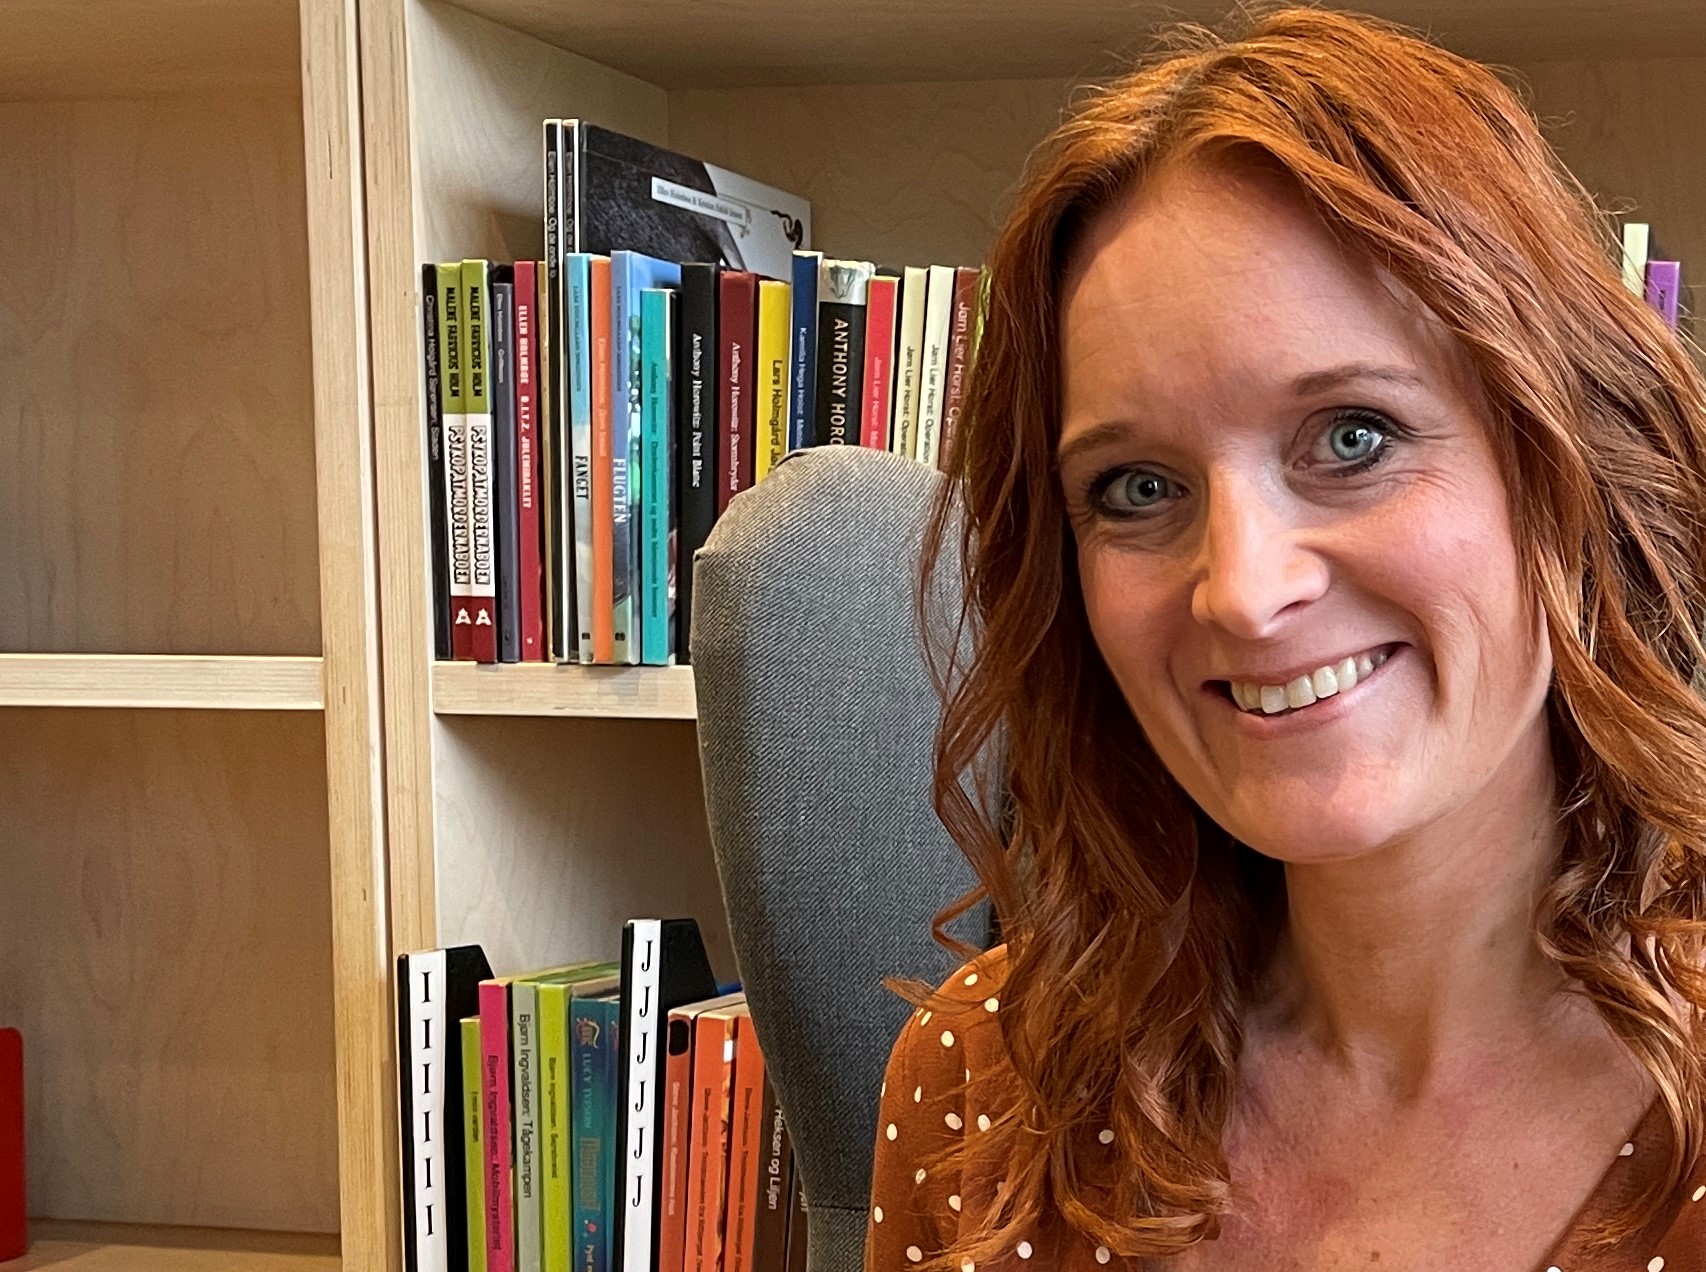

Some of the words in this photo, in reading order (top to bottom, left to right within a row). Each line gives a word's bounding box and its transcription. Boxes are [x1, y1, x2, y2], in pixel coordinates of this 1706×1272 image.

[518, 305, 528, 334] ELLEN
[690, 333, 702, 377] Anthony
[831, 318, 848, 398] ANTHONY
[575, 455, 589, 500] FANGET
[613, 458, 628, 523] FLUGTEN
[448, 424, 470, 585] PSYKOPATMORDERNABOEN
[472, 424, 491, 585] PSYKOPATMORDERNABOEN
[518, 1014, 530, 1046] Bjørn
[520, 1120, 534, 1198] Tågekampen
[768, 1158, 780, 1174] og
[766, 1176, 781, 1210] Liljen
